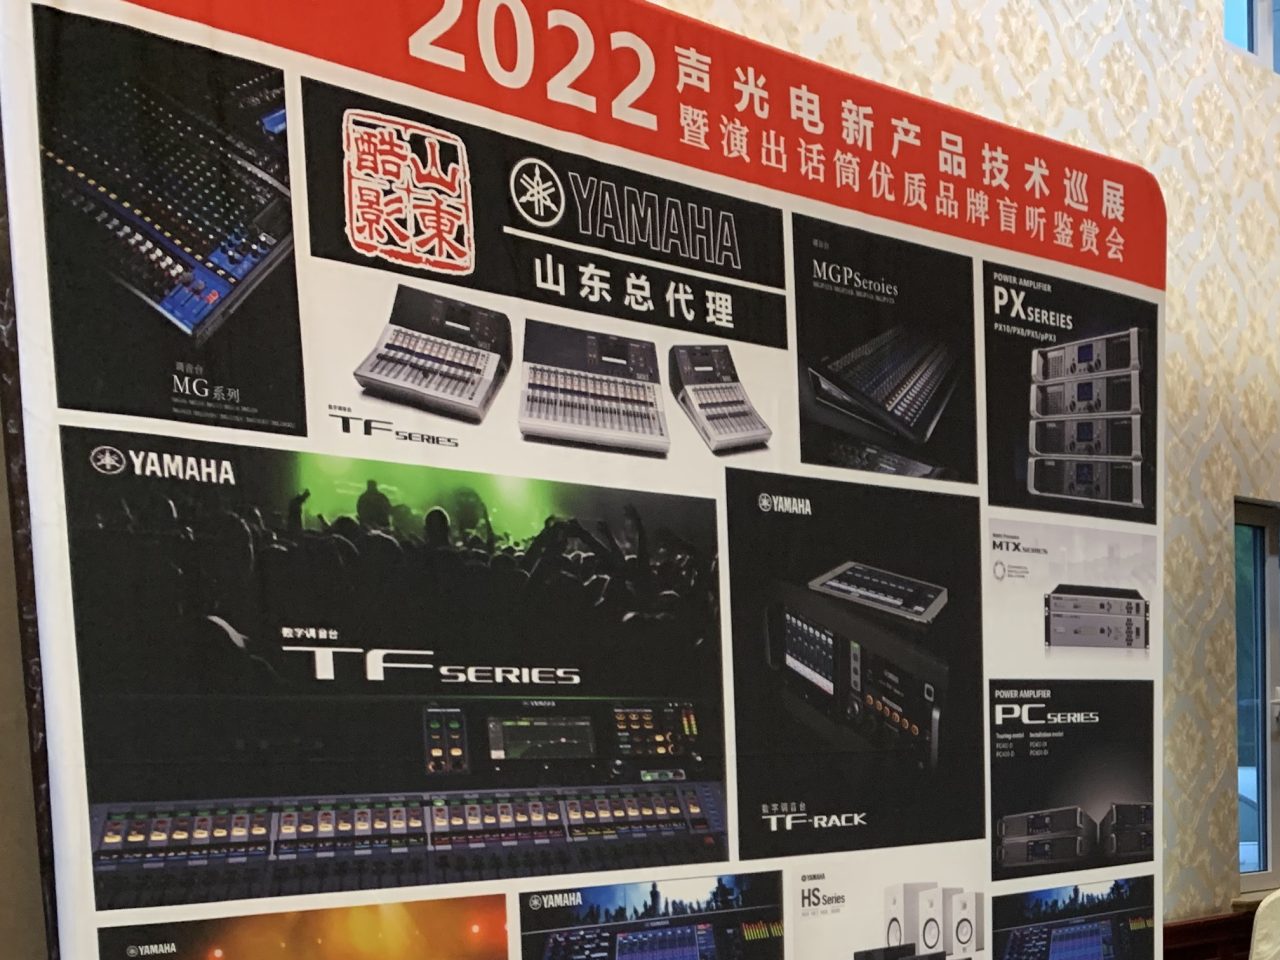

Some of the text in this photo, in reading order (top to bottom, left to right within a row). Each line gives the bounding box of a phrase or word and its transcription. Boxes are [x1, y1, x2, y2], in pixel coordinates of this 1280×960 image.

[407, 0, 659, 132] 2022
[674, 44, 1126, 224] 声光电新产品技术巡展
[678, 103, 1126, 264] 暨演出话筒优质品牌盲听鉴赏会
[568, 171, 742, 270] YAMAHA
[534, 253, 736, 329] 山东总代理
[993, 271, 1052, 293] POWER AMPLIFIER
[994, 284, 1073, 331] PX SEREIES
[172, 374, 240, 403] MG 系列
[328, 413, 459, 448] TF SERIES
[128, 449, 236, 487] YAMAHA
[773, 494, 812, 515] YAMAHA
[992, 539, 1021, 553] MTX
[281, 645, 581, 684] TF SERIES
[995, 689, 1052, 699] POWER AMPLIFIER
[994, 703, 1100, 726] PC SERIES
[761, 811, 868, 833] TF-RACK
[542, 891, 583, 908] YAMAHA
[801, 887, 846, 909] HS Series
[138, 942, 177, 956] YAMAHA
